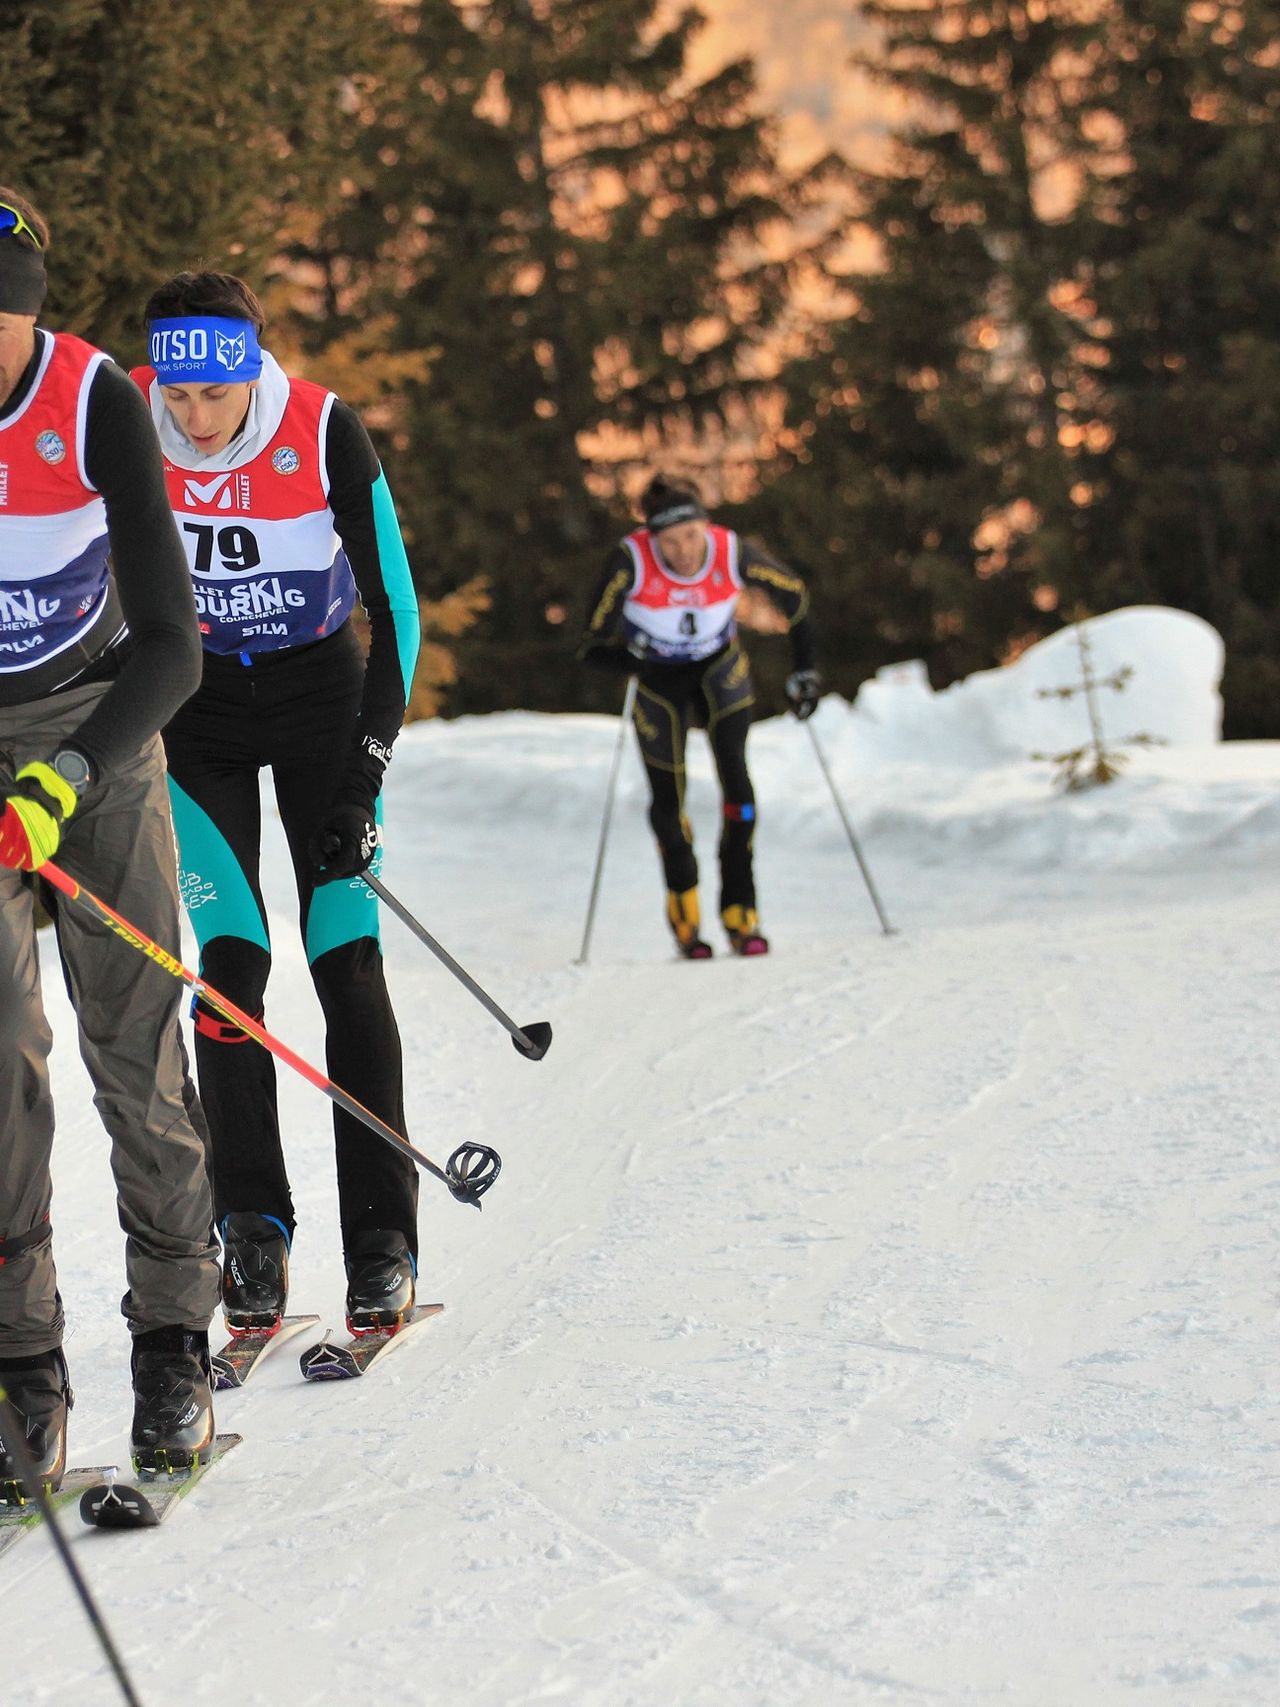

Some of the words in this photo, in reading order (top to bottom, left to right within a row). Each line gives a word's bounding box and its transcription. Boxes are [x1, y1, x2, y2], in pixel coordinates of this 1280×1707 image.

[151, 329, 208, 363] OTSO
[173, 362, 207, 371] SPORT
[240, 473, 251, 511] MILLET
[183, 521, 261, 573] 79
[191, 583, 224, 598] LLET
[230, 577, 283, 608] SKI
[193, 588, 306, 617] OURING
[219, 606, 289, 623] COURCHEVEL
[242, 623, 288, 637] SILVA
[230, 1256, 245, 1287] RACE
[178, 1402, 200, 1425] RACE
